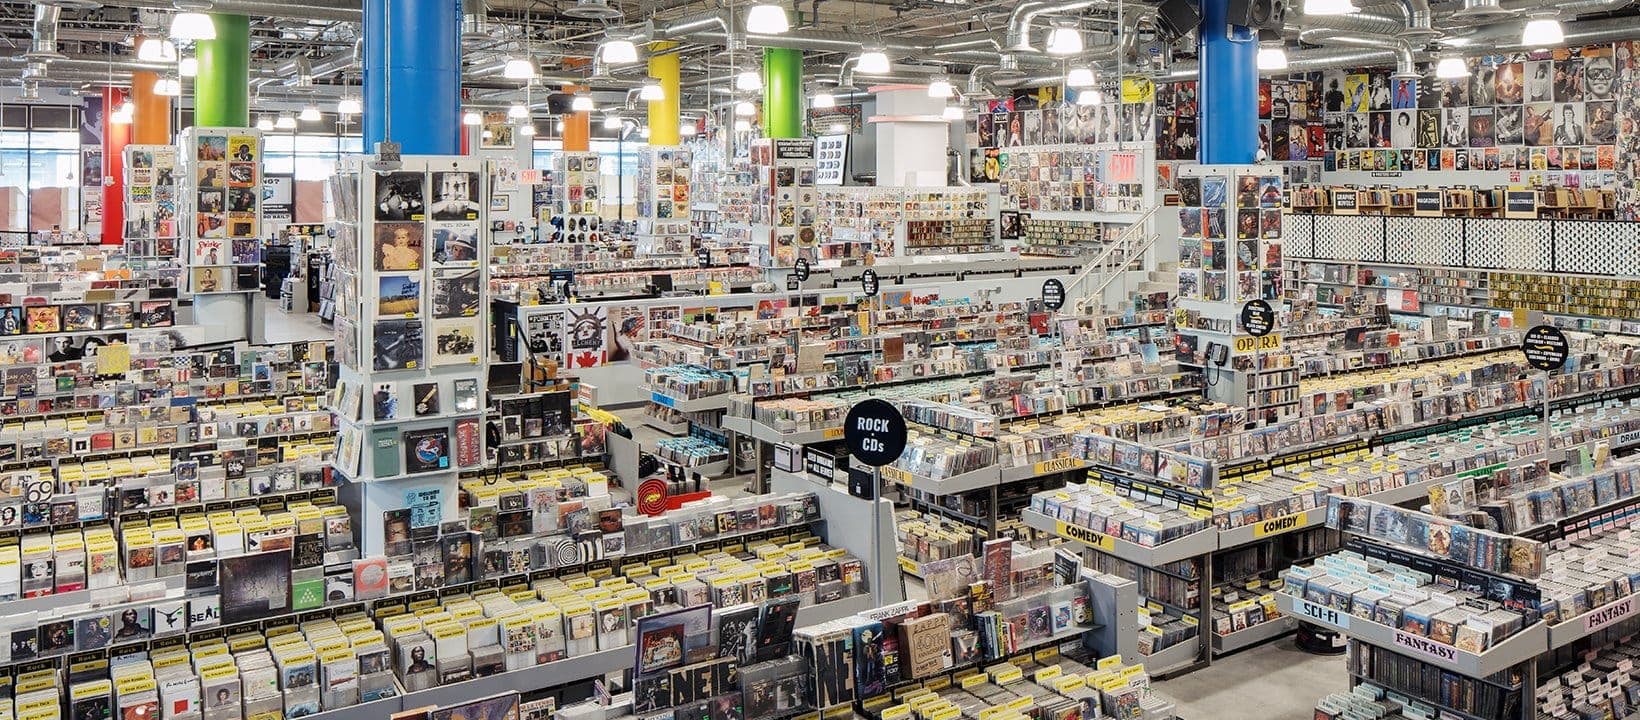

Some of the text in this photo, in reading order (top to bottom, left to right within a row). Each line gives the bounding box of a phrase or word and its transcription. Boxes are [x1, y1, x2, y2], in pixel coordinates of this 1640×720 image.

[857, 416, 890, 433] ROCK
[862, 437, 885, 453] CDs
[1043, 457, 1077, 473] CLASSICAL
[1263, 515, 1299, 533] COMEDY
[1066, 525, 1104, 546] COMEDY
[191, 605, 220, 623] SEAL
[1303, 602, 1339, 625] SCI-FI
[1588, 601, 1632, 628] FANTASY
[1396, 633, 1455, 660] FANTASY
